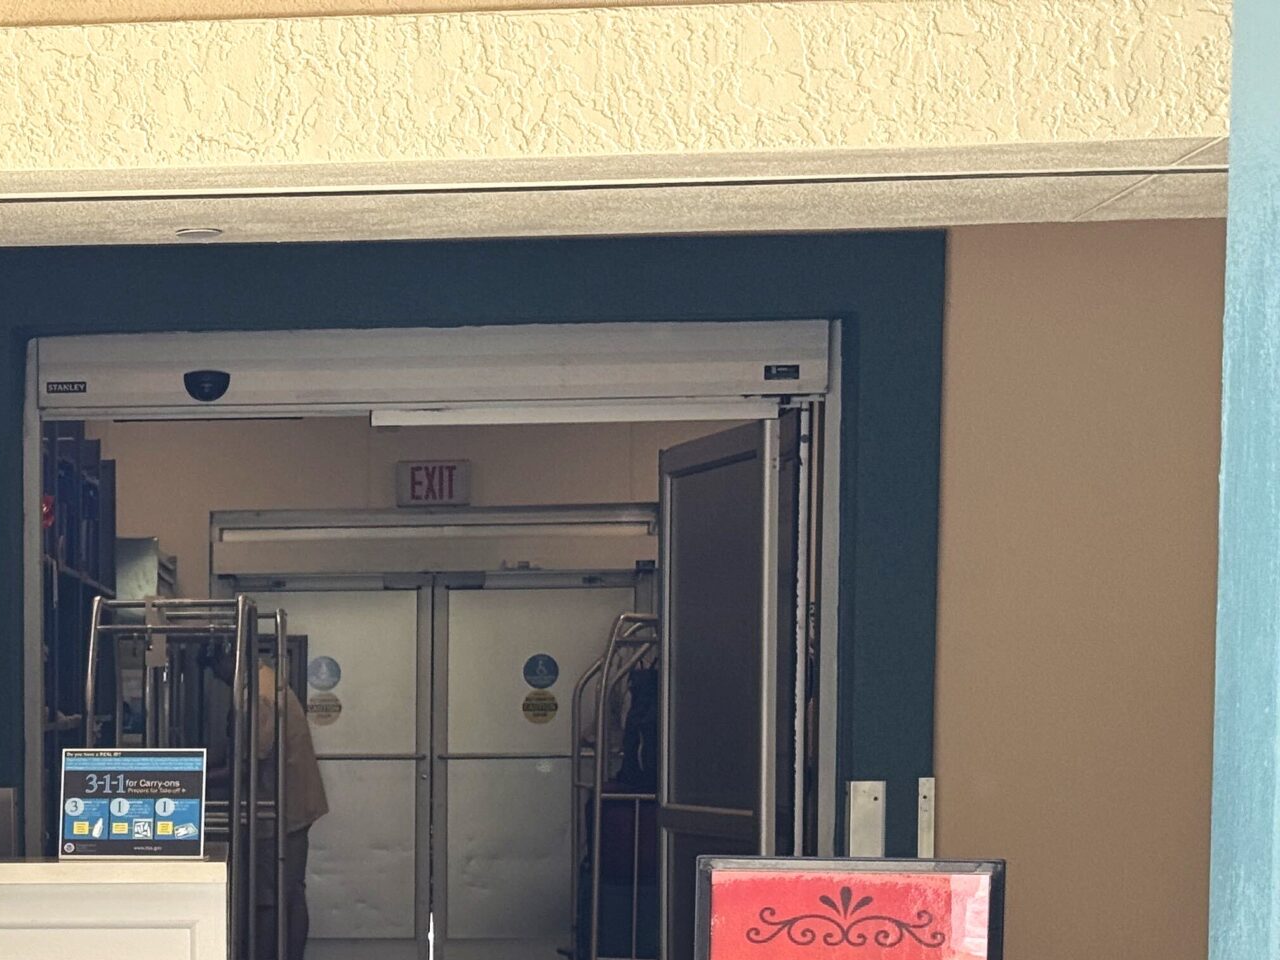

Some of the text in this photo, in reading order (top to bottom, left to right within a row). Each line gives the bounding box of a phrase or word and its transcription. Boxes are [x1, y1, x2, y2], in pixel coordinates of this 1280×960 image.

[48, 383, 85, 391] STANLEY
[410, 465, 457, 501] EXIT
[85, 773, 181, 794] 3-1-1 for Carry-ons
[69, 800, 79, 812] 3
